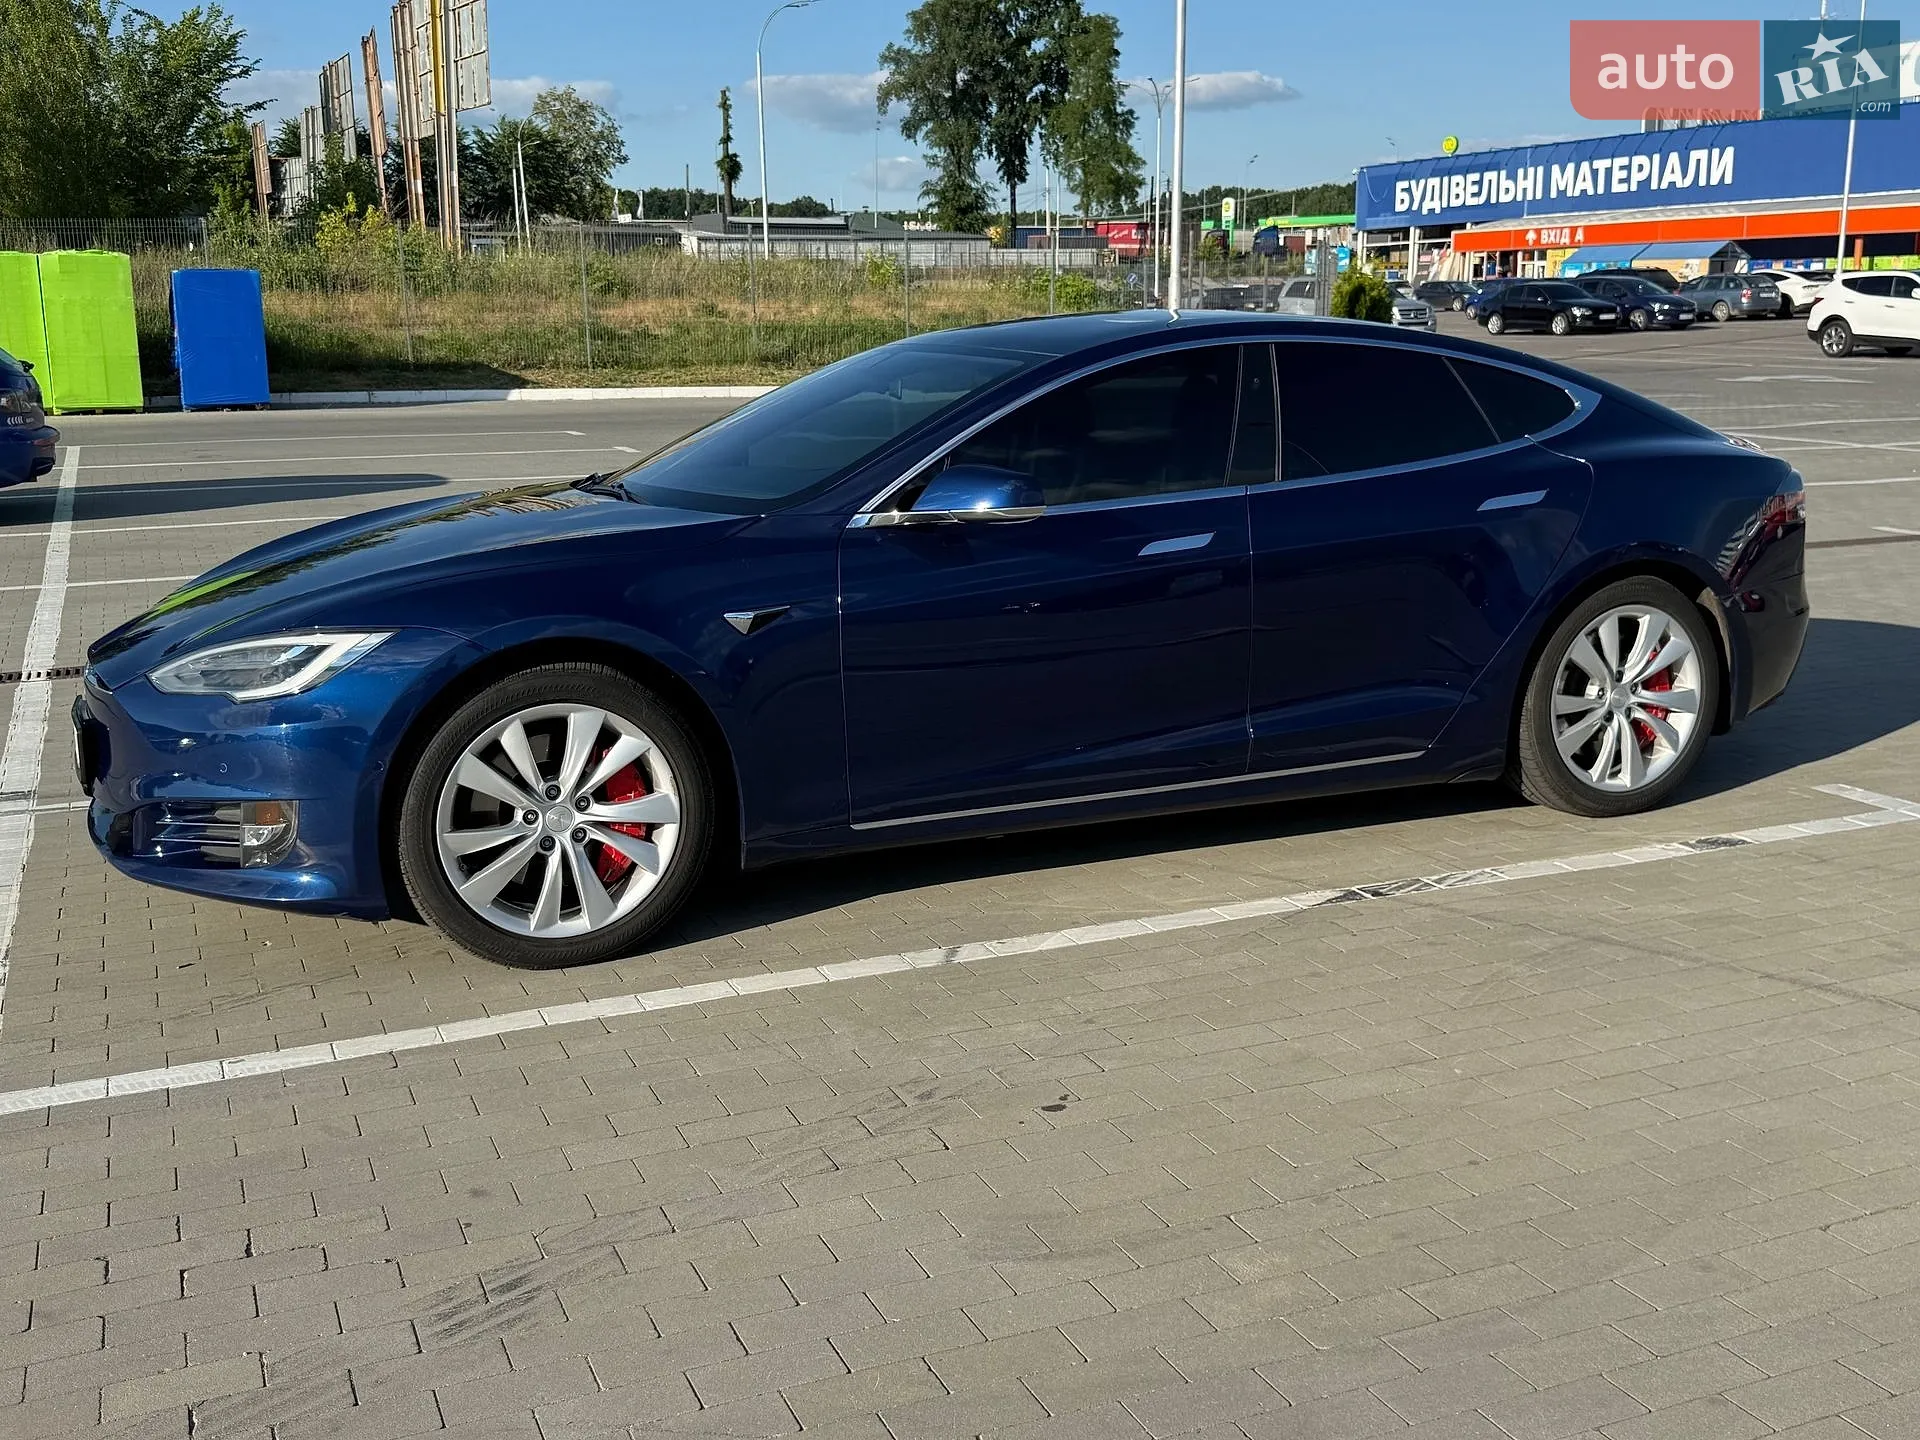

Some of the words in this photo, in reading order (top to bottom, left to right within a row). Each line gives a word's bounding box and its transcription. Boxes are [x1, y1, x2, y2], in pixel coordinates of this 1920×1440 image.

[1394, 165, 1544, 215] БУДІВЕЛЬНІ
[1549, 146, 1735, 199] МАТЕРІАЛИ
[1540, 229, 1571, 246] ВХІД
